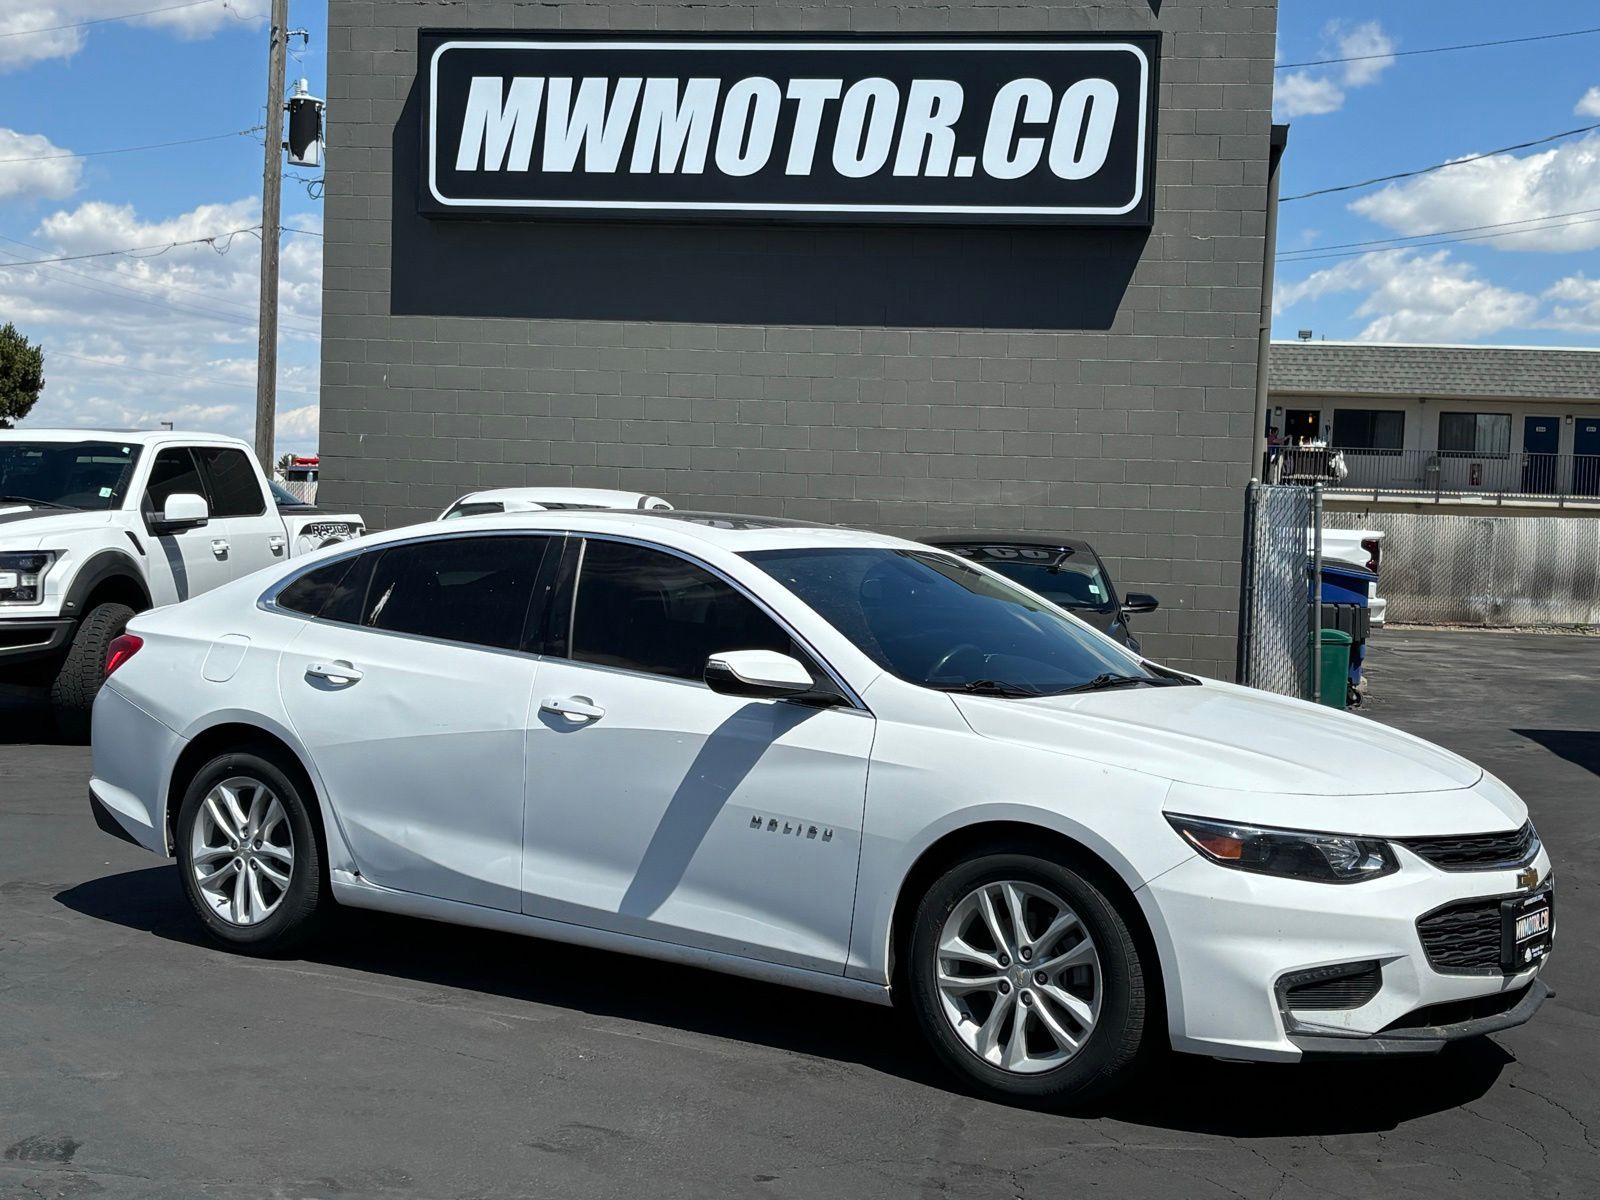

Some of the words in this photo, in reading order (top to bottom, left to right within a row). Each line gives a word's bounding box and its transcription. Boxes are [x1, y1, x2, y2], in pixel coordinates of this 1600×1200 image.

[456, 77, 1118, 180] MWMOTOR.CO
[311, 523, 351, 538] RAPTOR
[750, 815, 833, 842] MALIBU
